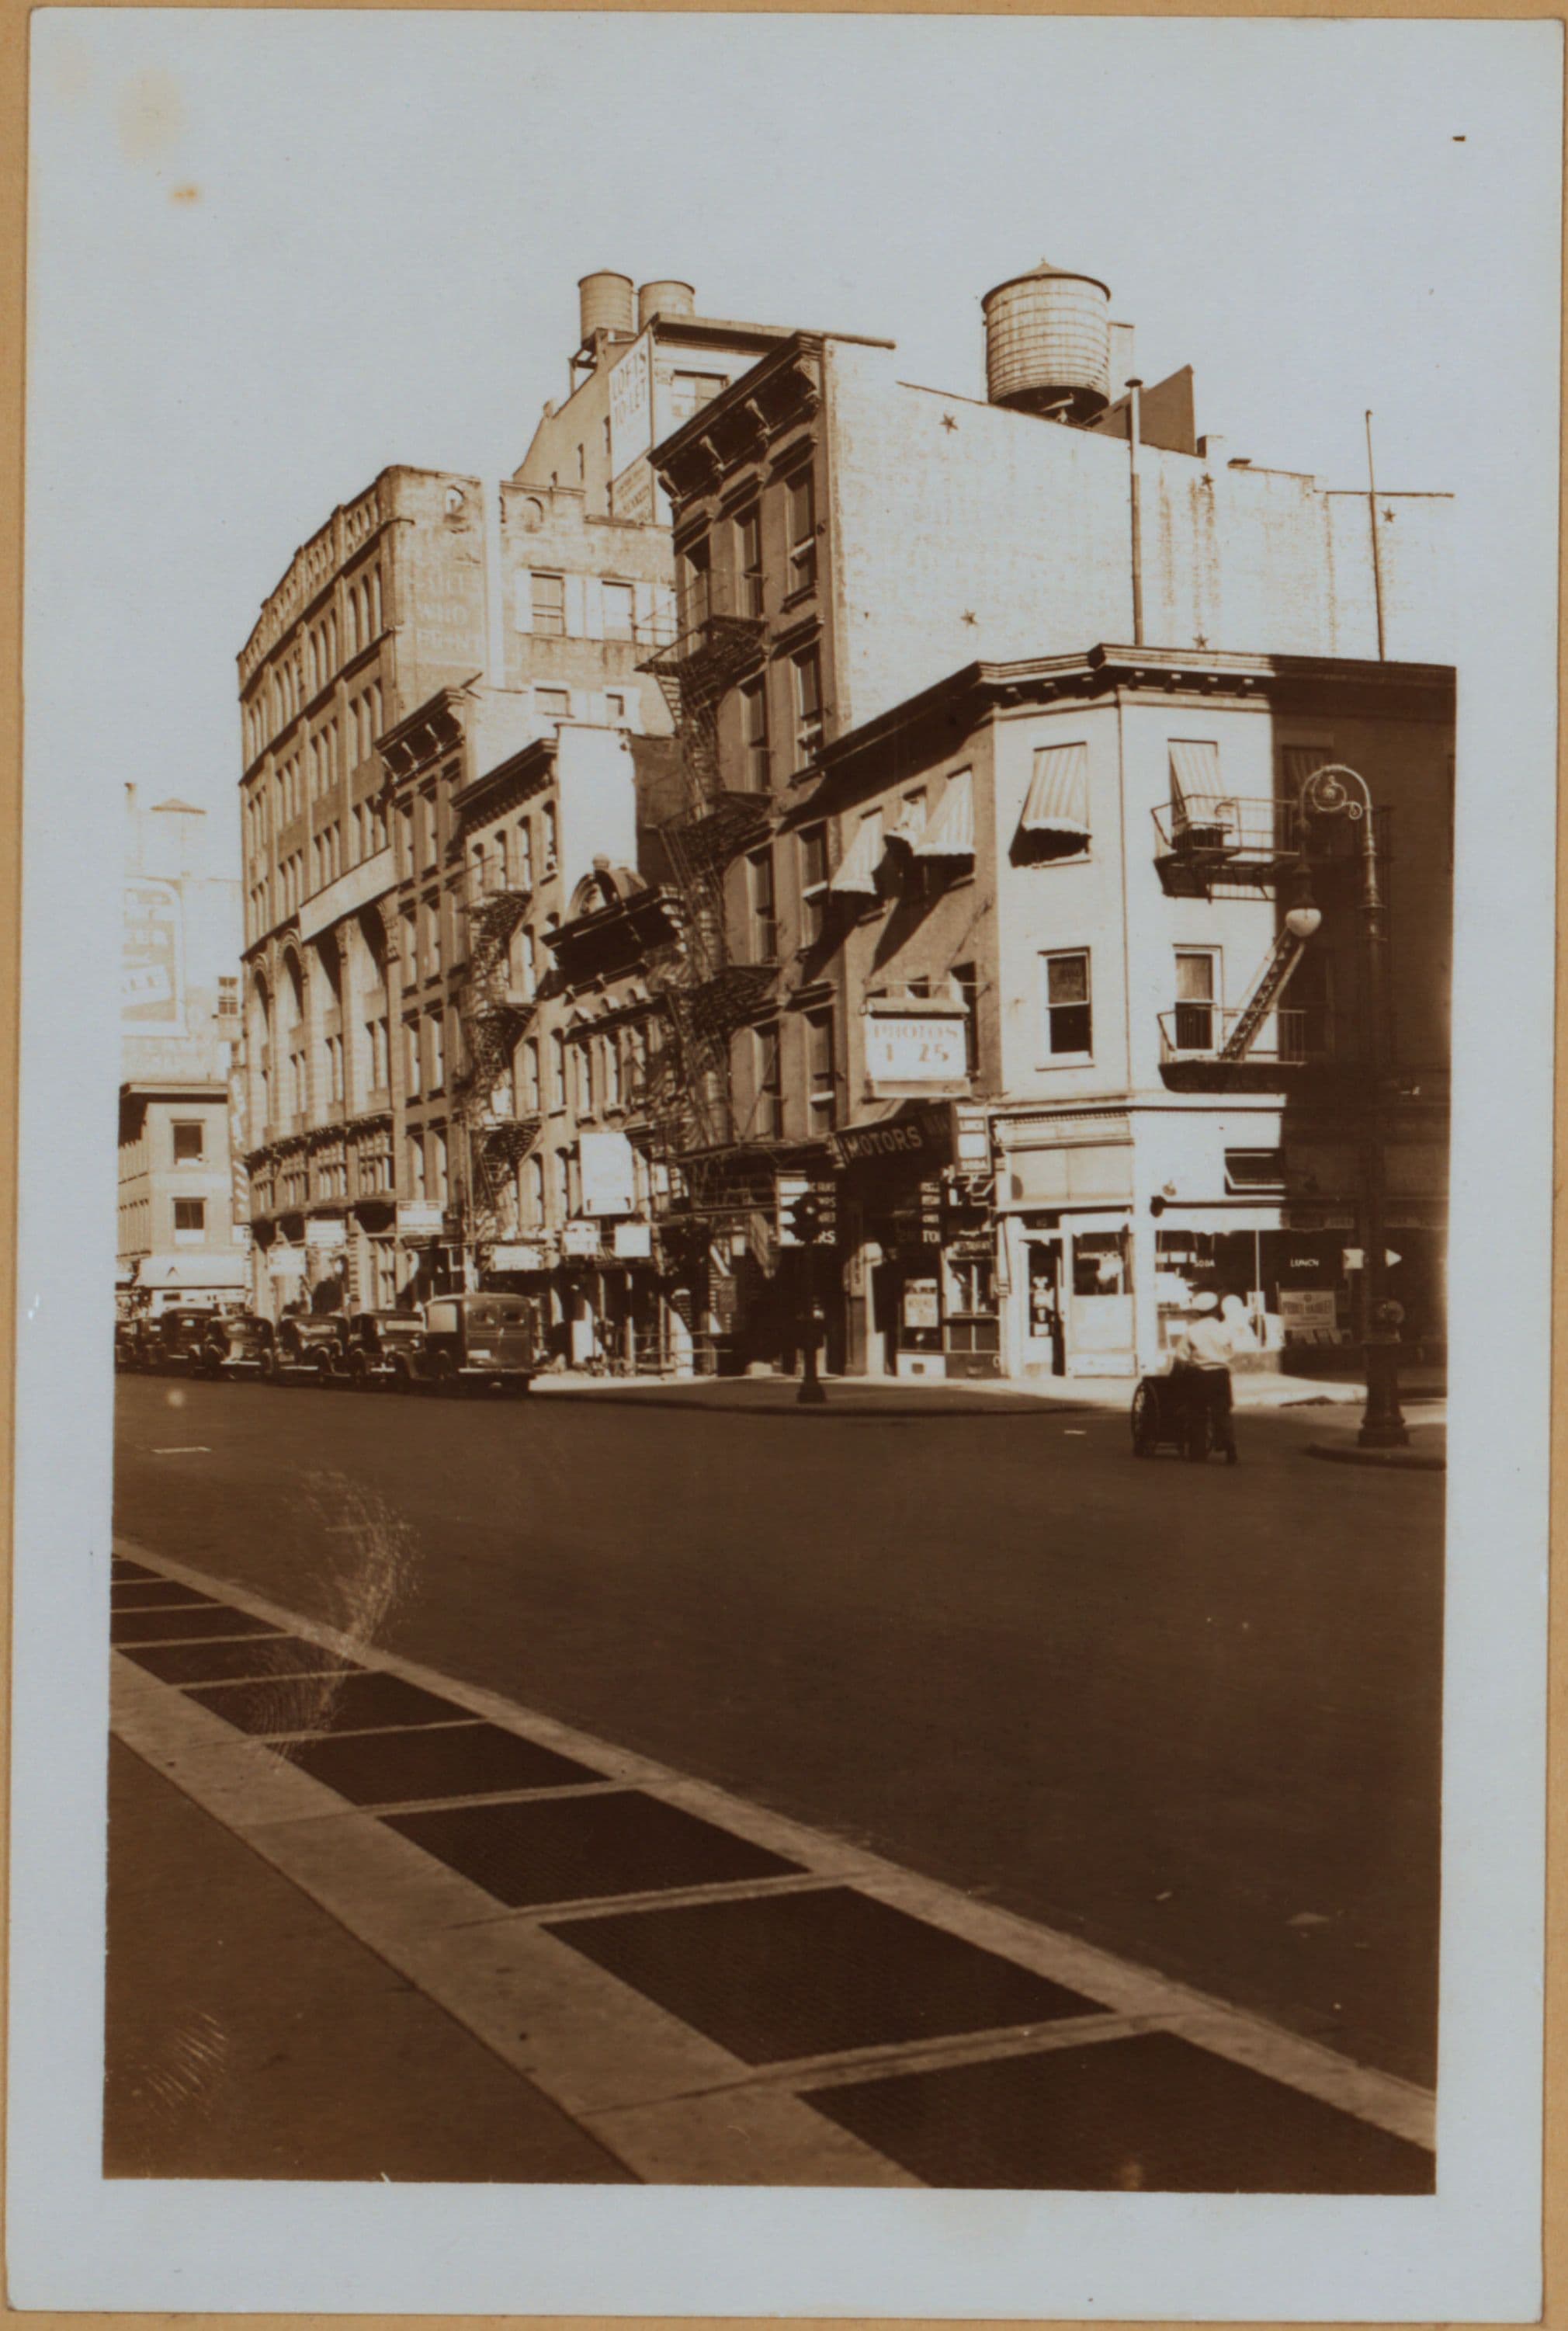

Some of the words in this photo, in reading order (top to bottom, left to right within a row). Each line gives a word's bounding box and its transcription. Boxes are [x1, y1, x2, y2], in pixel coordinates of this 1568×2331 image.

[873, 1024, 958, 1038] PHOTOS
[845, 1125, 924, 1159] MOTORS
[1290, 1259, 1320, 1268] LUNCH
